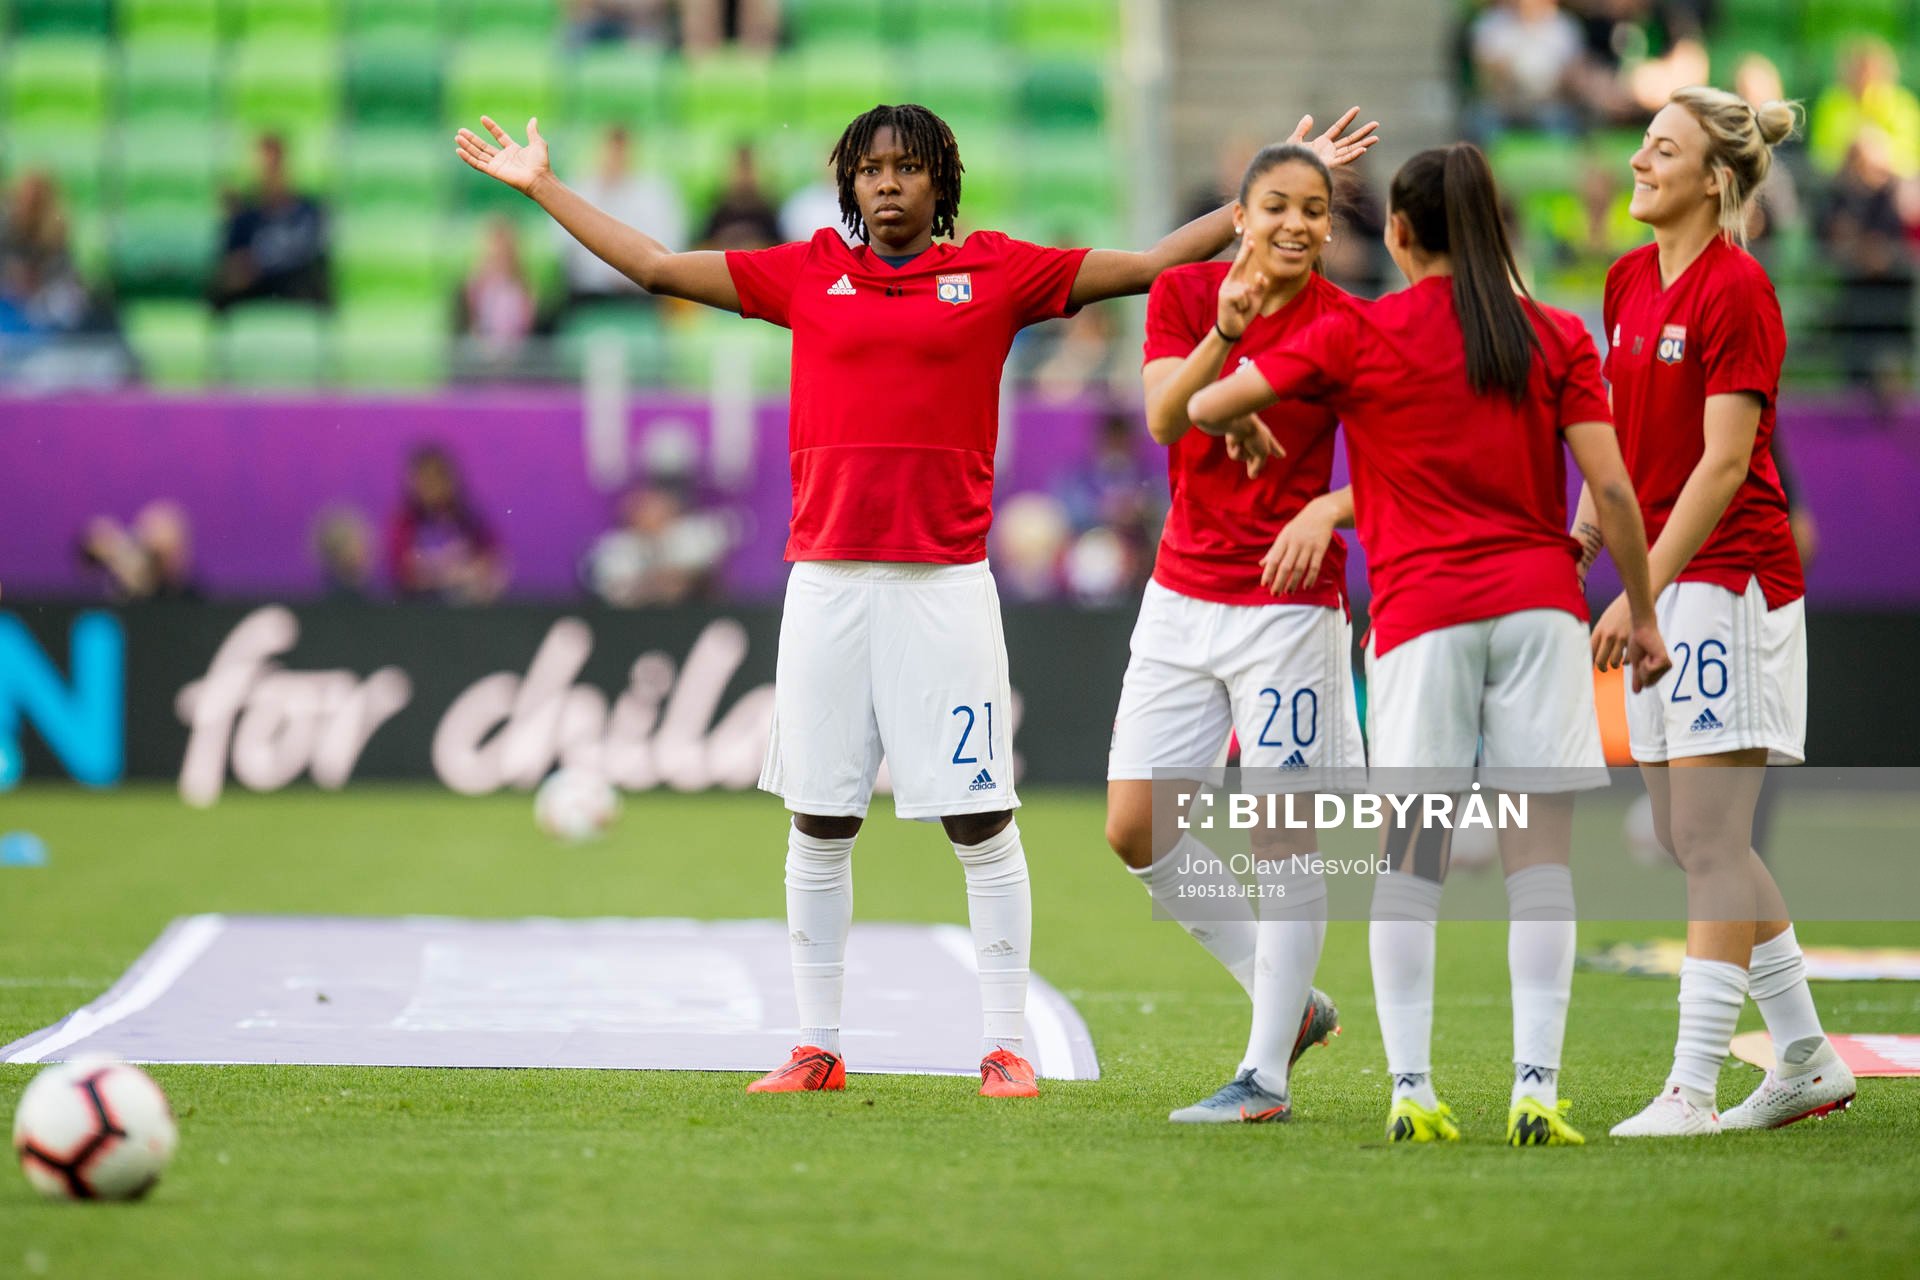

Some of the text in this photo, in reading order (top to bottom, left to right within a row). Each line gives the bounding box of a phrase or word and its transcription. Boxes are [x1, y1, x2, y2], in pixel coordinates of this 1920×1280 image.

[940, 284, 970, 300] OL
[1660, 339, 1683, 360] OL
[1671, 639, 1728, 702] 26
[175, 604, 412, 808] for
[952, 702, 993, 764] 21
[1258, 687, 1317, 748] 20
[968, 782, 997, 791] adidas
